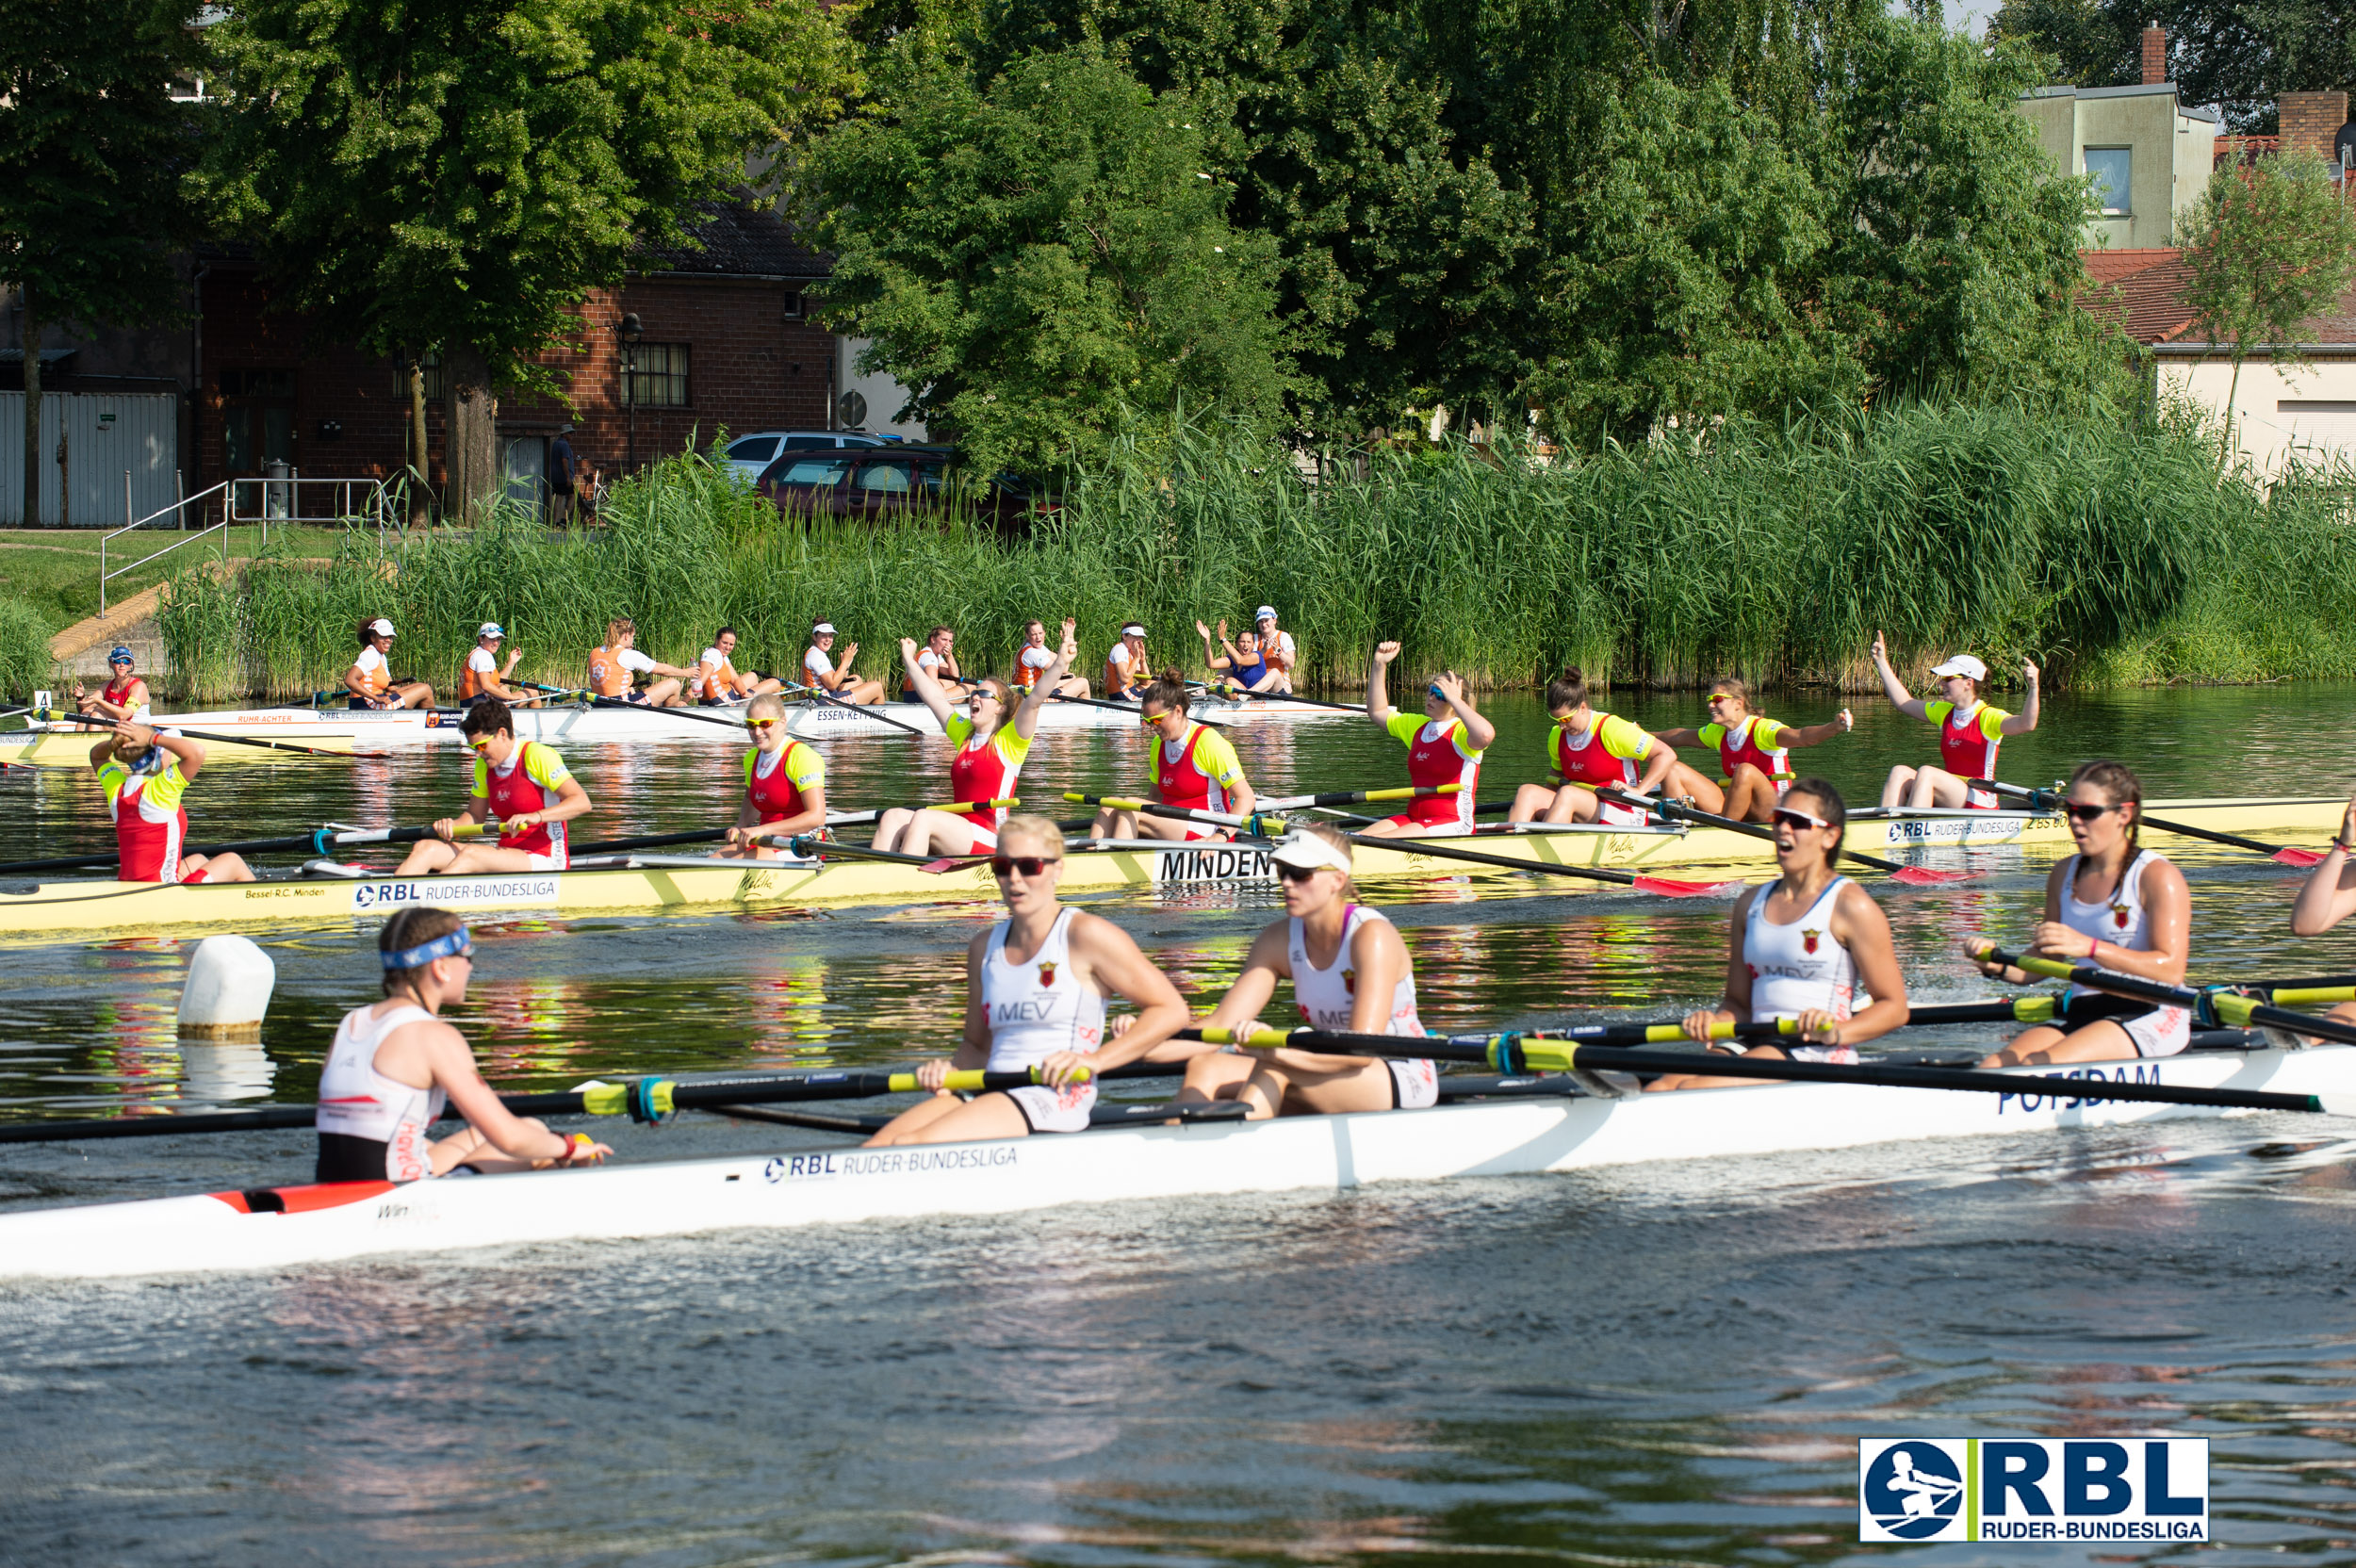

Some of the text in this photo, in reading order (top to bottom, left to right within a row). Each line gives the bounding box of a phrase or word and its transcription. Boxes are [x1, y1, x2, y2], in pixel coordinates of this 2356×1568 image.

[41, 693, 48, 705] 4
[238, 715, 292, 724] RUHR-ACHTER
[1904, 821, 2020, 837] RBL RUDER-BUNDESLIGA
[1161, 851, 1270, 880] MINDEN
[294, 888, 325, 897] Minden
[378, 882, 554, 902] RBL RUDER-BUNDESLIGA
[998, 1002, 1054, 1021] MEV
[1317, 1009, 1351, 1025] ME
[791, 1147, 1017, 1175] RBL RUDER-BUNDESLIGA
